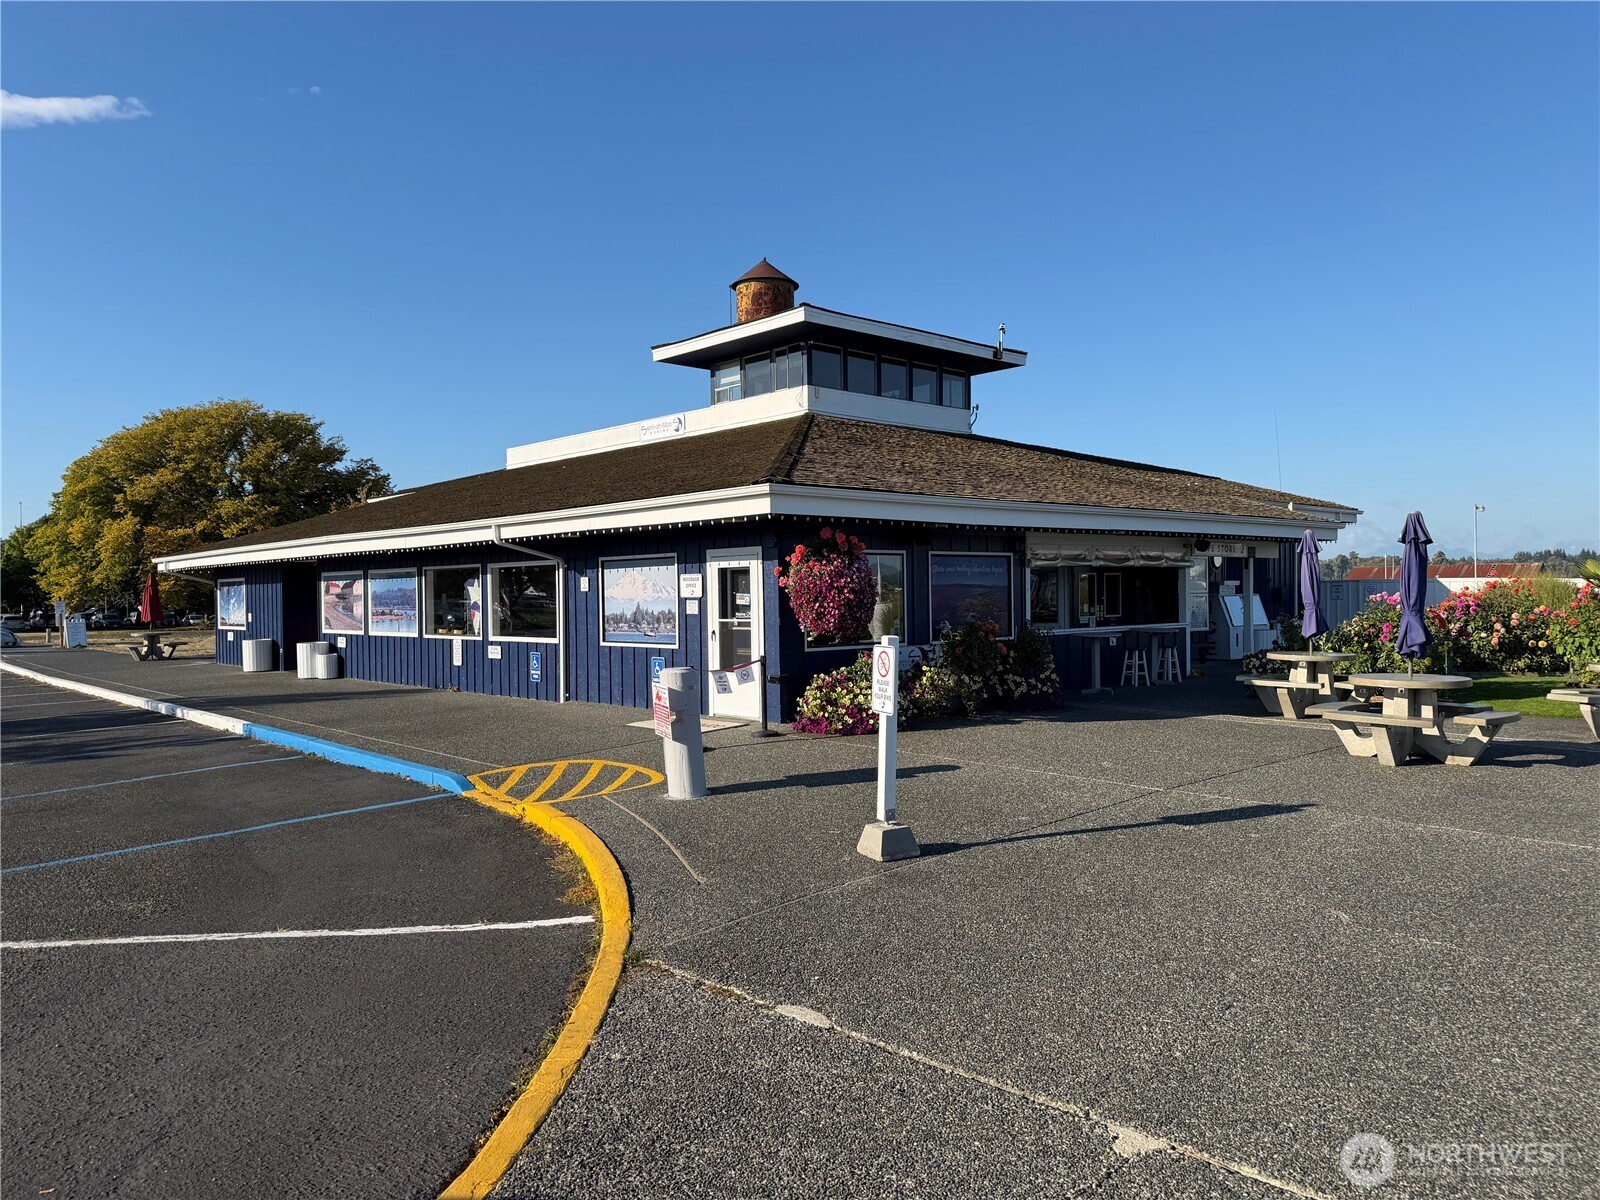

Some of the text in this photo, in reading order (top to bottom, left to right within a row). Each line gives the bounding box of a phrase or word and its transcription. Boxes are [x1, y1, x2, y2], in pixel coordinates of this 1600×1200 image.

[1217, 544, 1236, 553] STORE
[876, 679, 890, 687] PLEASE
[884, 694, 892, 702] BIKE
